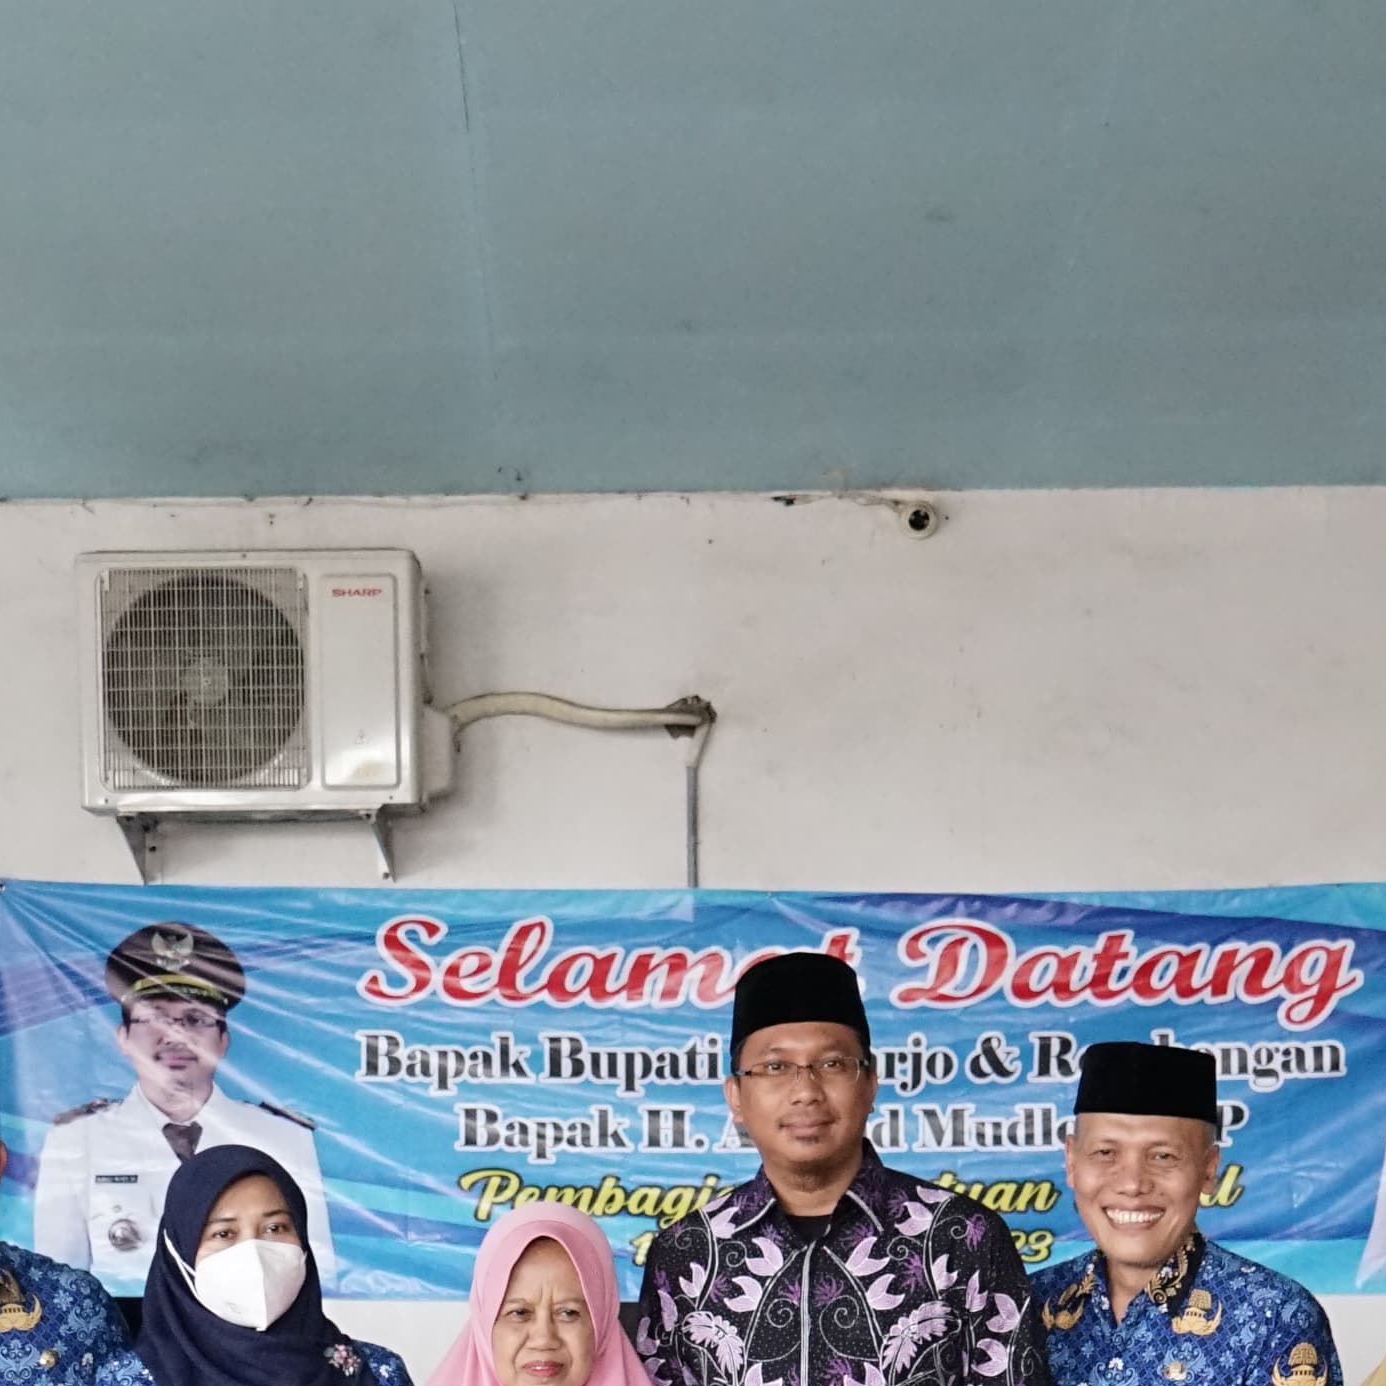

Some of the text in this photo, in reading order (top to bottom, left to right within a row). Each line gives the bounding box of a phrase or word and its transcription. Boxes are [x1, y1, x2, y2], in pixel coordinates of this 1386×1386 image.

[332, 588, 382, 597] SHARP
[360, 916, 1361, 1028] Selamt Datang
[358, 1031, 533, 1094] Bapak
[542, 1033, 721, 1095] Bupati
[968, 1033, 1021, 1082] &
[456, 1104, 632, 1162] Bapak
[641, 1106, 707, 1152] H.
